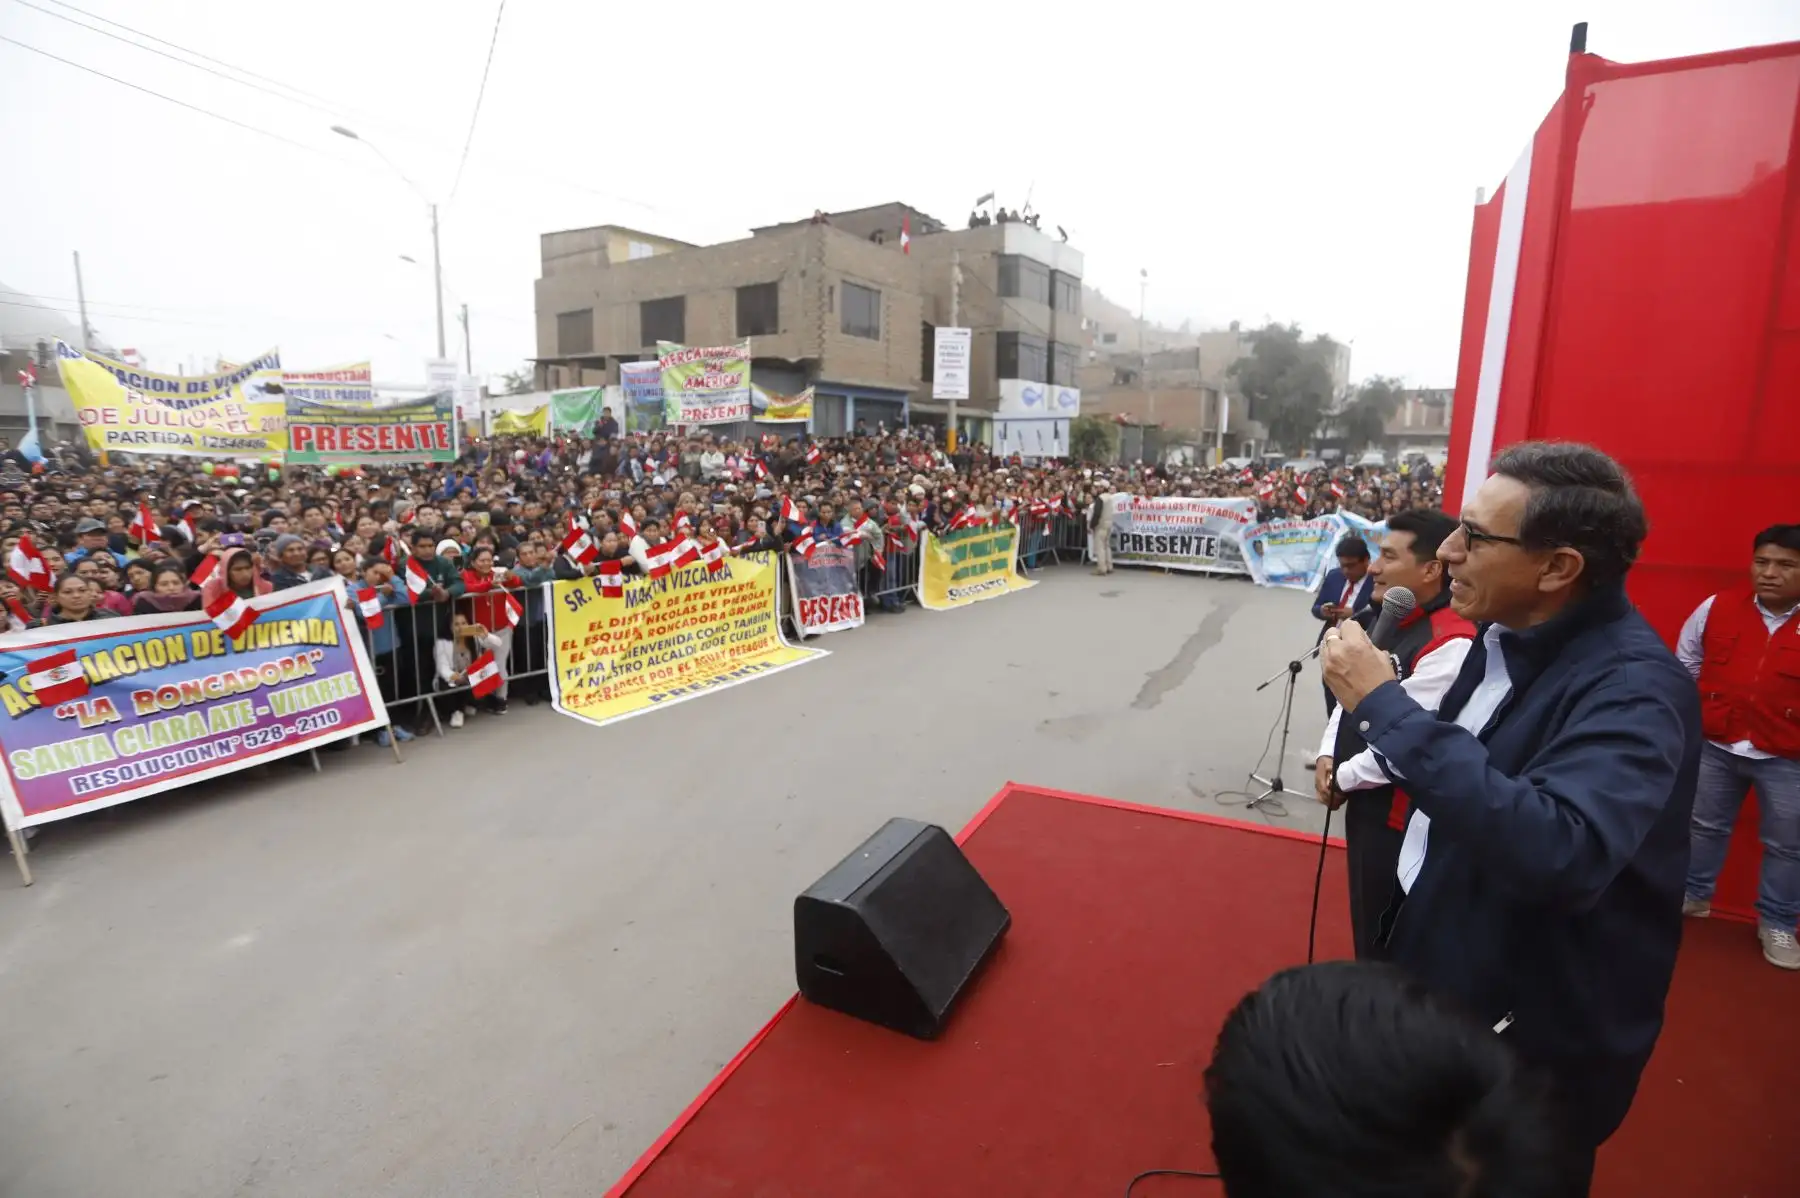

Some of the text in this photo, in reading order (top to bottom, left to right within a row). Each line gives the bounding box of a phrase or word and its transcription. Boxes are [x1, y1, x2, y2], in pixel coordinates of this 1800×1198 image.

[187, 381, 210, 393] DE
[106, 430, 194, 446] PARTIDA
[292, 424, 449, 451] PRESENTE
[1120, 533, 1215, 557] PRESENTE
[564, 588, 592, 612] SR.
[589, 620, 603, 632] EL
[666, 596, 679, 607] DE
[684, 588, 706, 603] ATE
[191, 630, 225, 658] DE
[231, 619, 340, 653] VIVIENDA
[561, 640, 578, 651] EL
[646, 605, 697, 625] NICOLAS
[702, 599, 717, 612] DE
[570, 652, 585, 663] EL
[647, 612, 727, 638] RONCADORA
[728, 601, 768, 617] GRANDE
[729, 624, 768, 643] CUELLAR
[565, 667, 581, 680] TE
[587, 661, 605, 673] DA
[696, 622, 730, 640] COMO
[649, 666, 673, 681] POR
[678, 661, 691, 673] EL
[11, 734, 115, 779] SANTA
[116, 711, 208, 756] CLARA
[209, 700, 257, 733] ATE
[268, 673, 361, 717] VITARTE
[71, 742, 214, 794] RESOLUCION
[245, 727, 284, 748] 528
[298, 709, 340, 734] 2110
